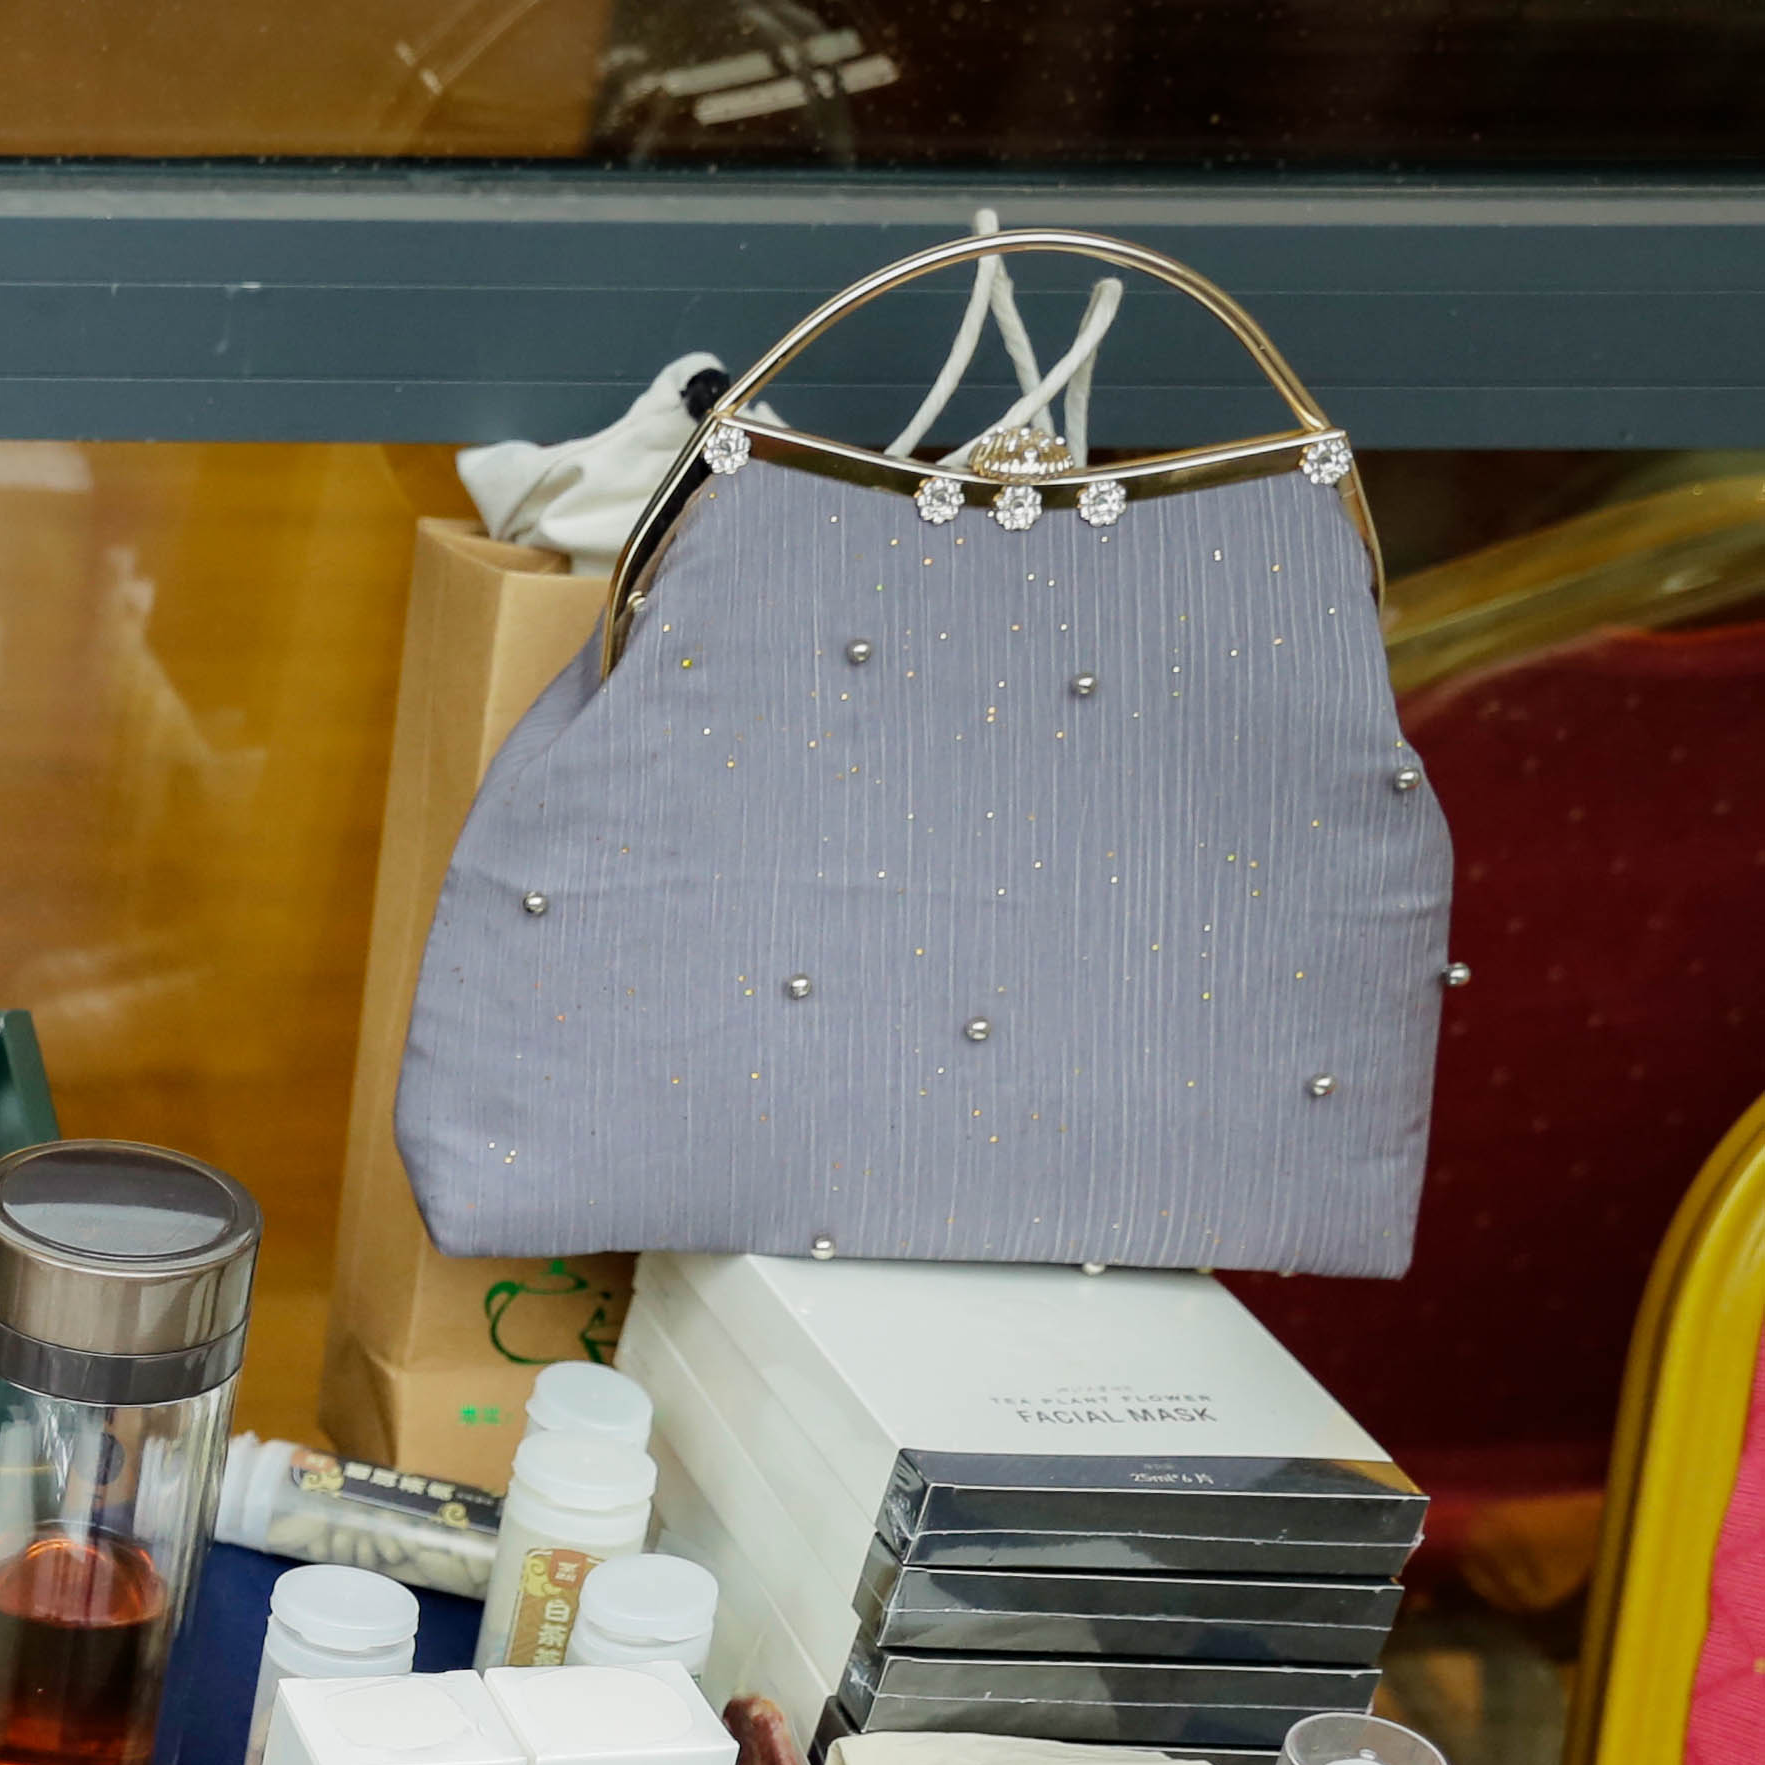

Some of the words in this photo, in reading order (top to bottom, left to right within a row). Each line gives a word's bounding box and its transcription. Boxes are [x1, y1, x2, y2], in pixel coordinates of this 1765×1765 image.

[1016, 1409, 1125, 1424] FACIAL
[1126, 1407, 1217, 1423] MASK
[534, 1599, 571, 1666] 白茶茶
